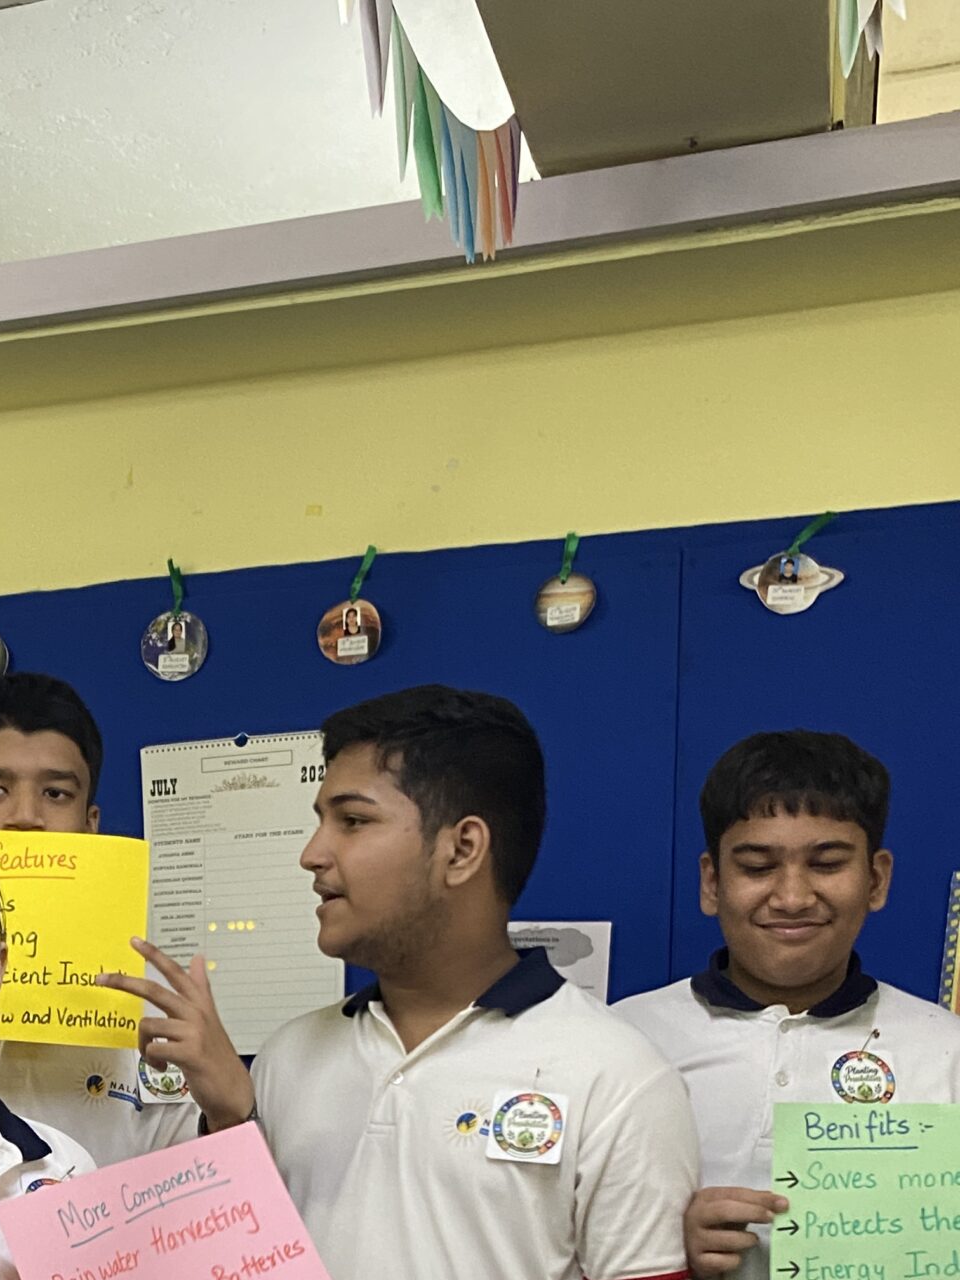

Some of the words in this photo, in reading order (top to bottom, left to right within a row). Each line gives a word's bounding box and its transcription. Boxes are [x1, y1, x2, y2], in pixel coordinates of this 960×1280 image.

[301, 765, 325, 783] 202
[150, 778, 177, 796] JULY
[2, 966, 53, 986] cient
[22, 1006, 52, 1025] and
[56, 1007, 137, 1031] Ventilation
[845, 1065, 879, 1076] Planting
[110, 1081, 138, 1095] NALA
[512, 1109, 549, 1121] Planting
[800, 1161, 876, 1190] Saves
[898, 1170, 960, 1189] mone
[57, 1199, 111, 1238] More
[120, 1158, 218, 1215] Components
[805, 1210, 903, 1238] Protects
